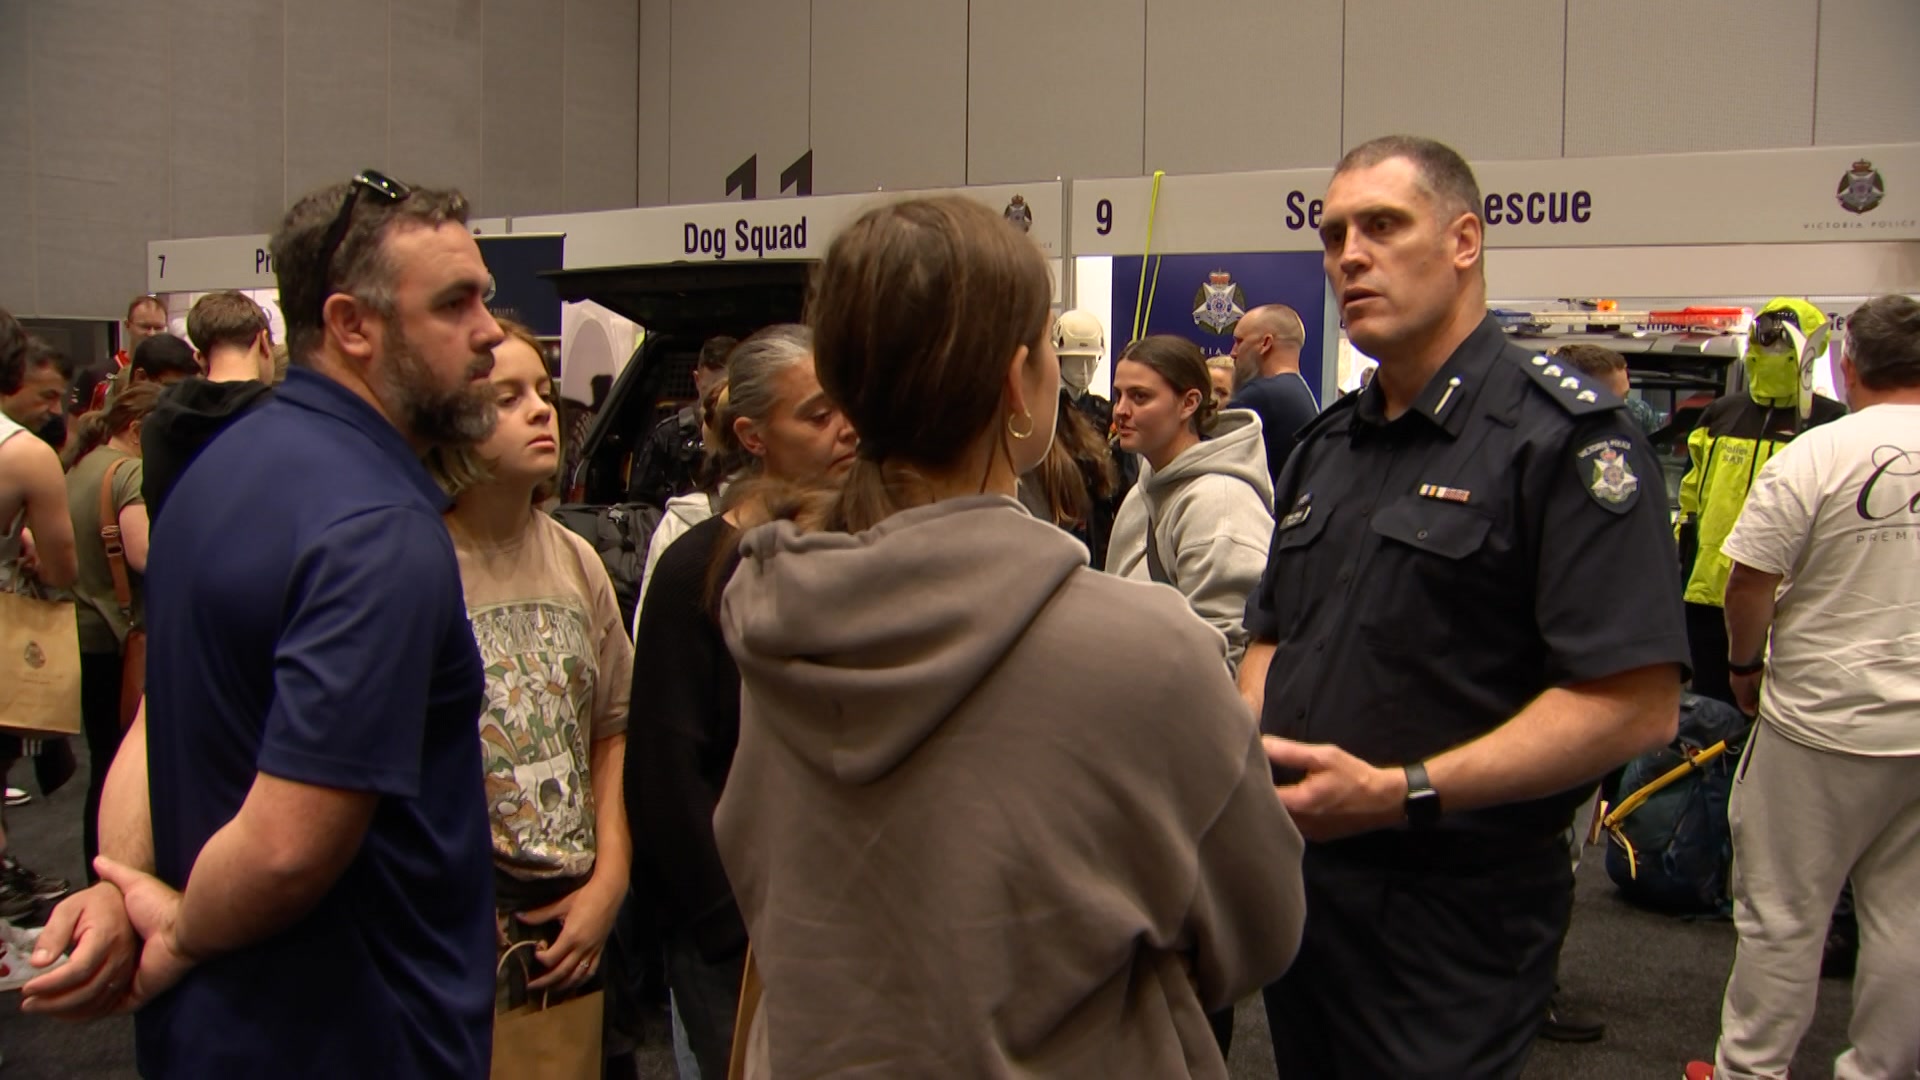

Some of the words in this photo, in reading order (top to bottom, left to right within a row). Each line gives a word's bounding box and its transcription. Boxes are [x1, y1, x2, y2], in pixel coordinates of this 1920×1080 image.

[1096, 198, 1114, 236] 9
[1286, 190, 1323, 230] Se
[1484, 190, 1592, 225] escue
[1803, 221, 1863, 230] VICTORIA
[1870, 219, 1917, 229] POLICE
[684, 222, 726, 259] Dog
[735, 216, 807, 258] Squad
[158, 254, 167, 279] 7
[1827, 312, 1845, 331] Te
